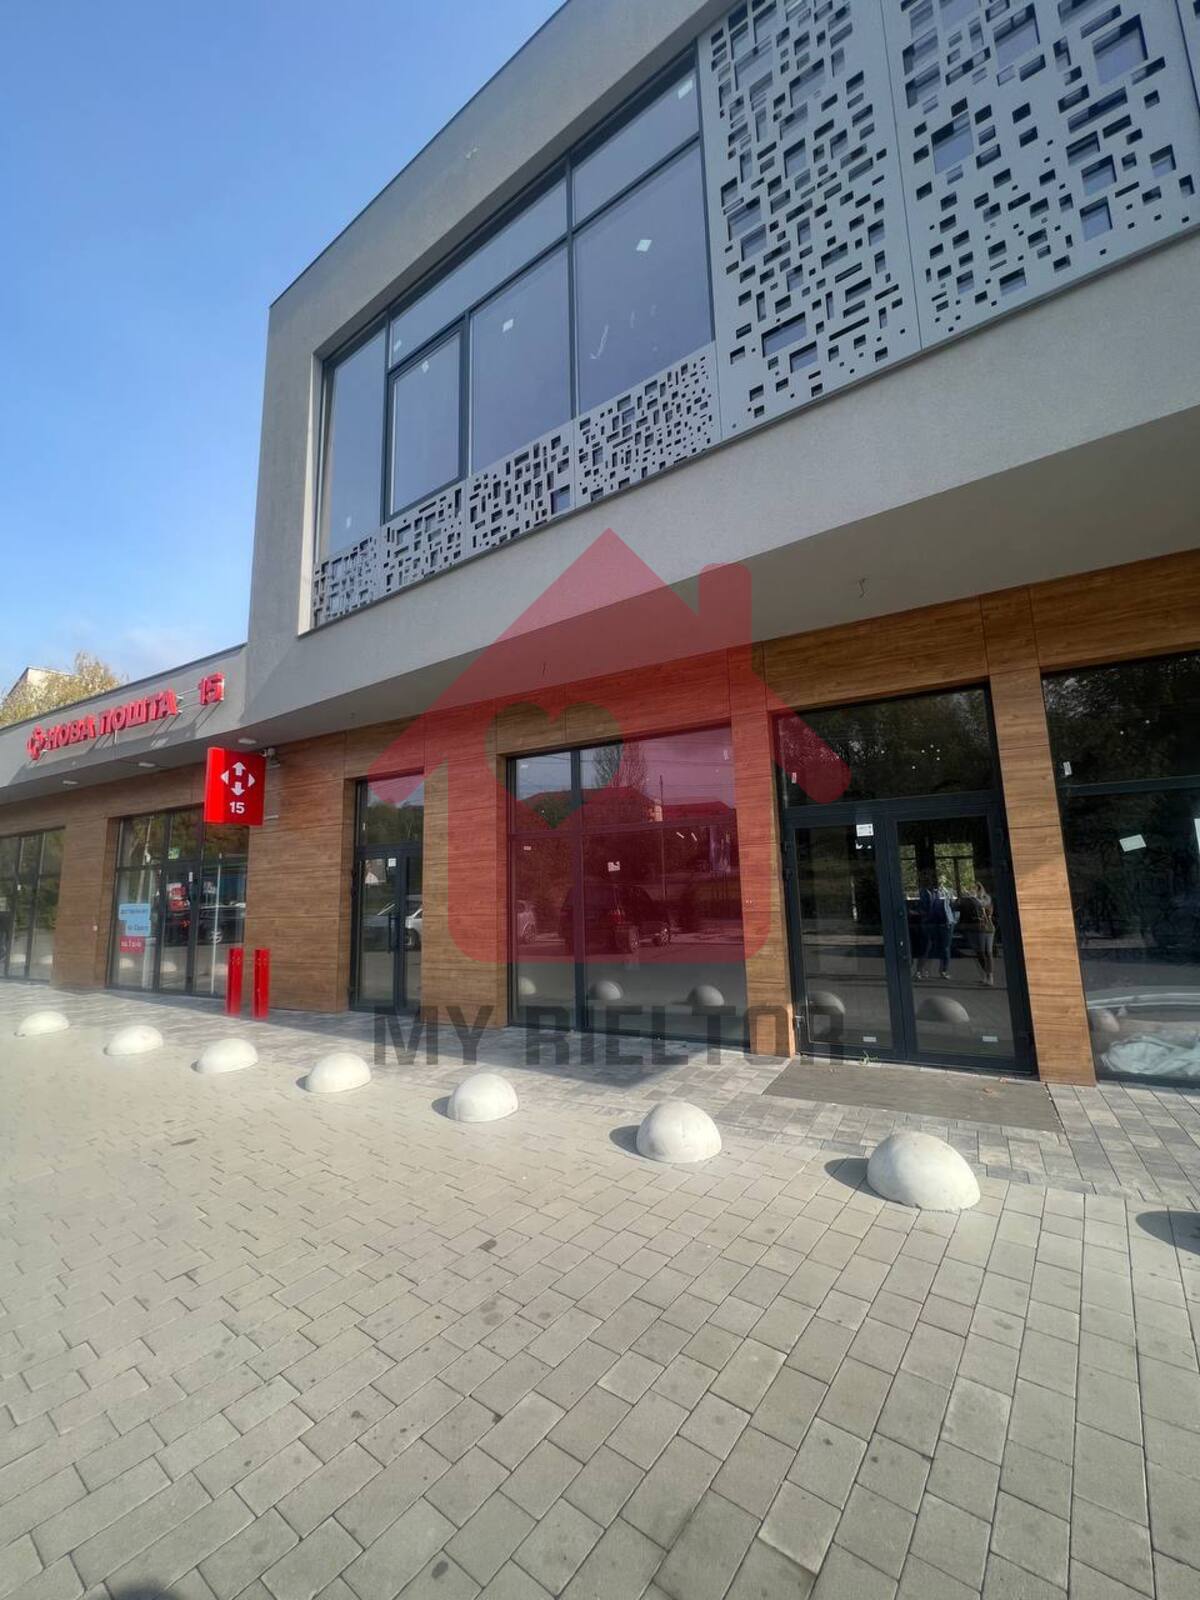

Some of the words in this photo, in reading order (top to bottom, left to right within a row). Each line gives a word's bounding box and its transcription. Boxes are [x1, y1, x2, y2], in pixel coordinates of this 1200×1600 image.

[46, 714, 97, 750] НОВА
[99, 689, 178, 735] ПОШТА
[198, 672, 225, 705] 15
[229, 801, 245, 815] 15
